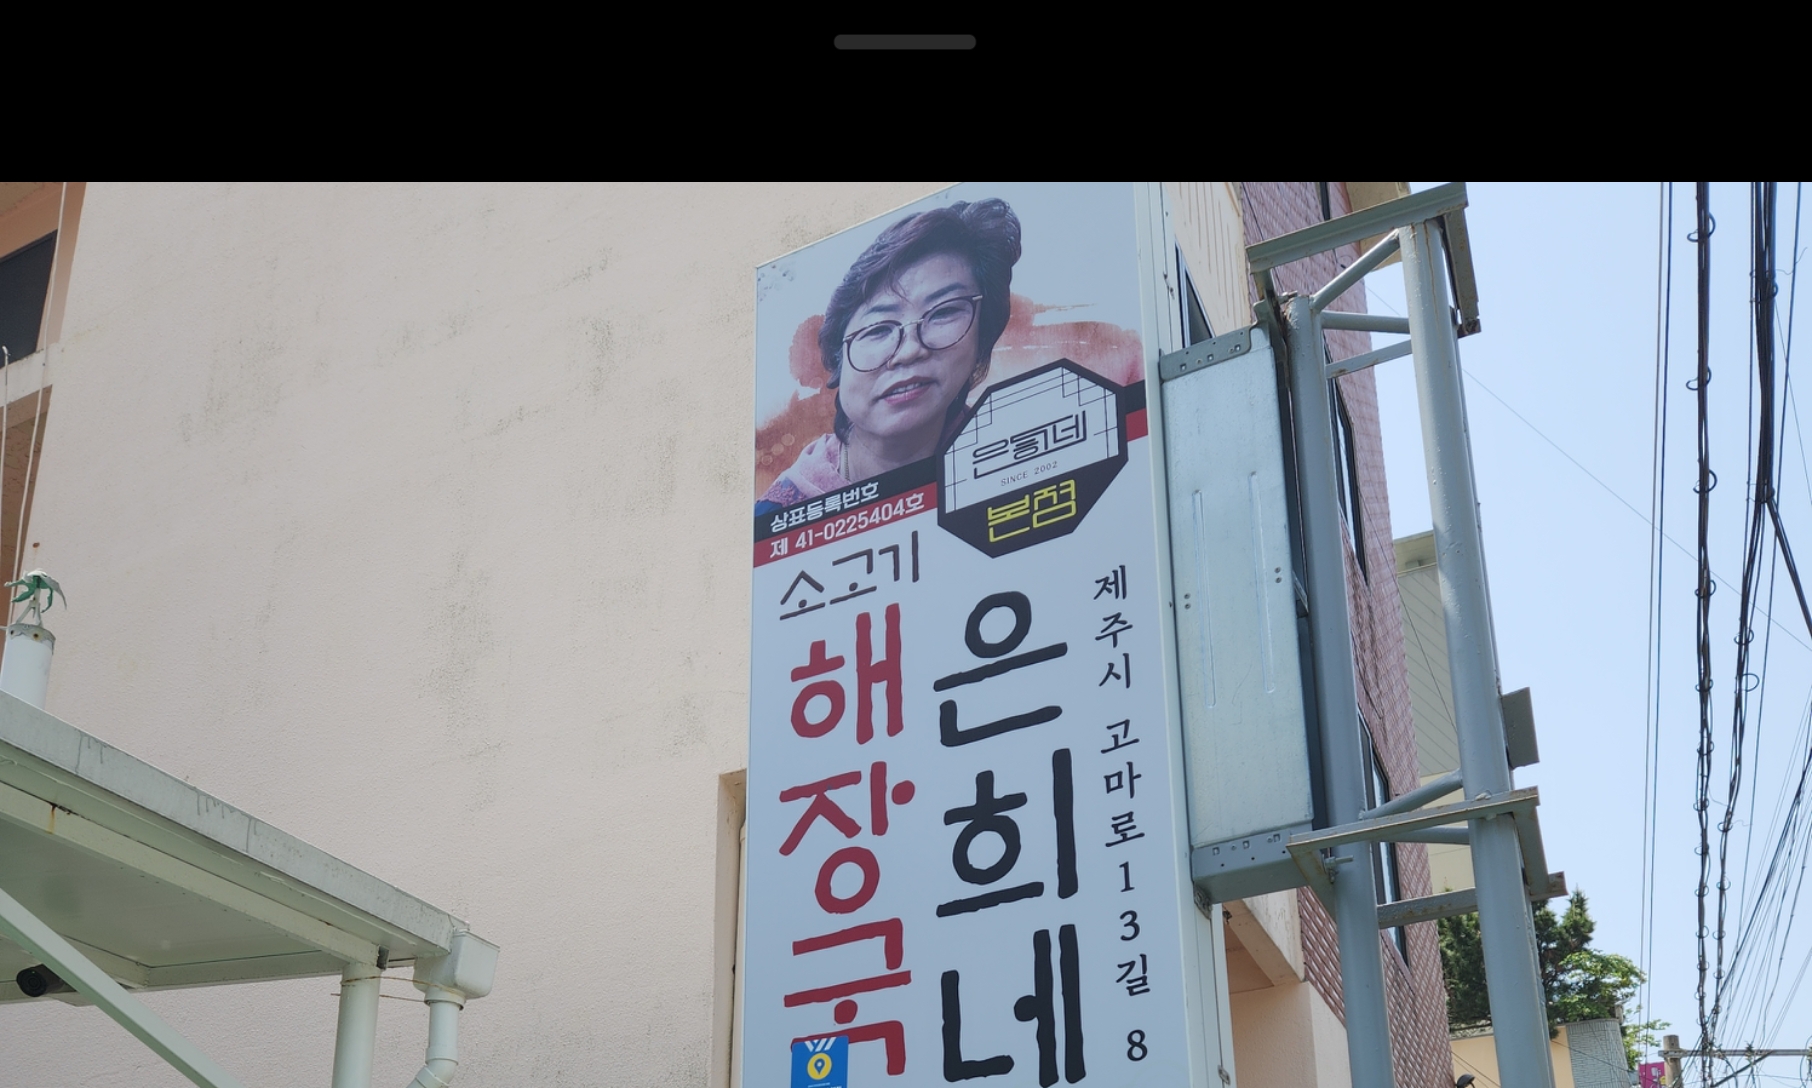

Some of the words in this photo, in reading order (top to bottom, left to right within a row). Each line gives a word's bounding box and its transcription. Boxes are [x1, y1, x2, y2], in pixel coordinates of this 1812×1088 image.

[770, 481, 880, 533] 상표등록번호
[987, 479, 1077, 543] 본점
[1001, 470, 1028, 487] SINCE
[1034, 460, 1058, 476] 2002
[769, 537, 789, 559] 제
[795, 492, 925, 550] 41-0225404호
[780, 530, 920, 621] 소고기
[1094, 564, 1133, 689] 제주시
[779, 602, 916, 1076] 해장국
[933, 591, 1086, 1088] 은희네
[1100, 718, 1151, 997] 고마로13길
[1126, 1029, 1149, 1062] 8
